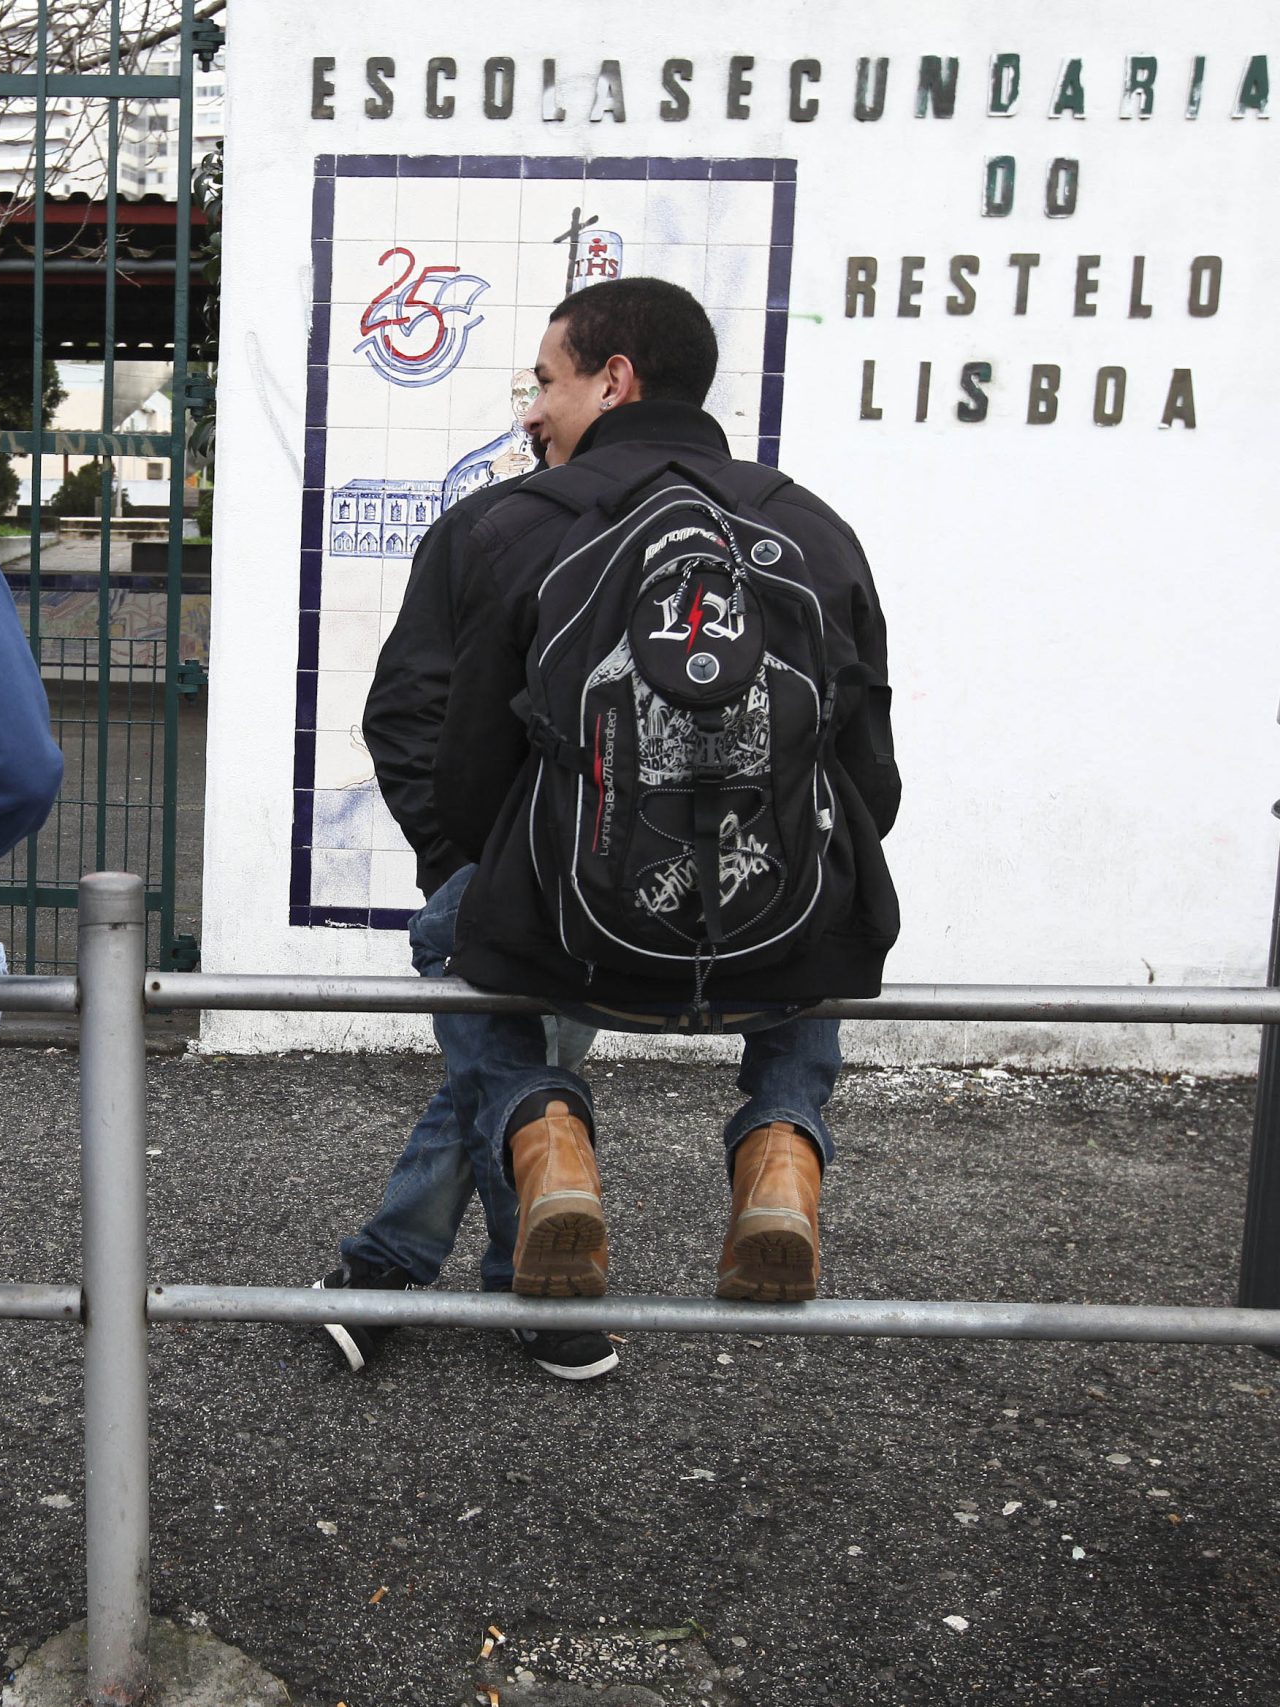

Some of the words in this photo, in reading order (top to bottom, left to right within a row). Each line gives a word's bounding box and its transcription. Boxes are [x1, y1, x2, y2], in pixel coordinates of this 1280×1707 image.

[981, 155, 1080, 219] DO
[361, 247, 460, 361] 25
[844, 254, 1223, 319] RESTELO
[859, 359, 1198, 430] LISBOA
